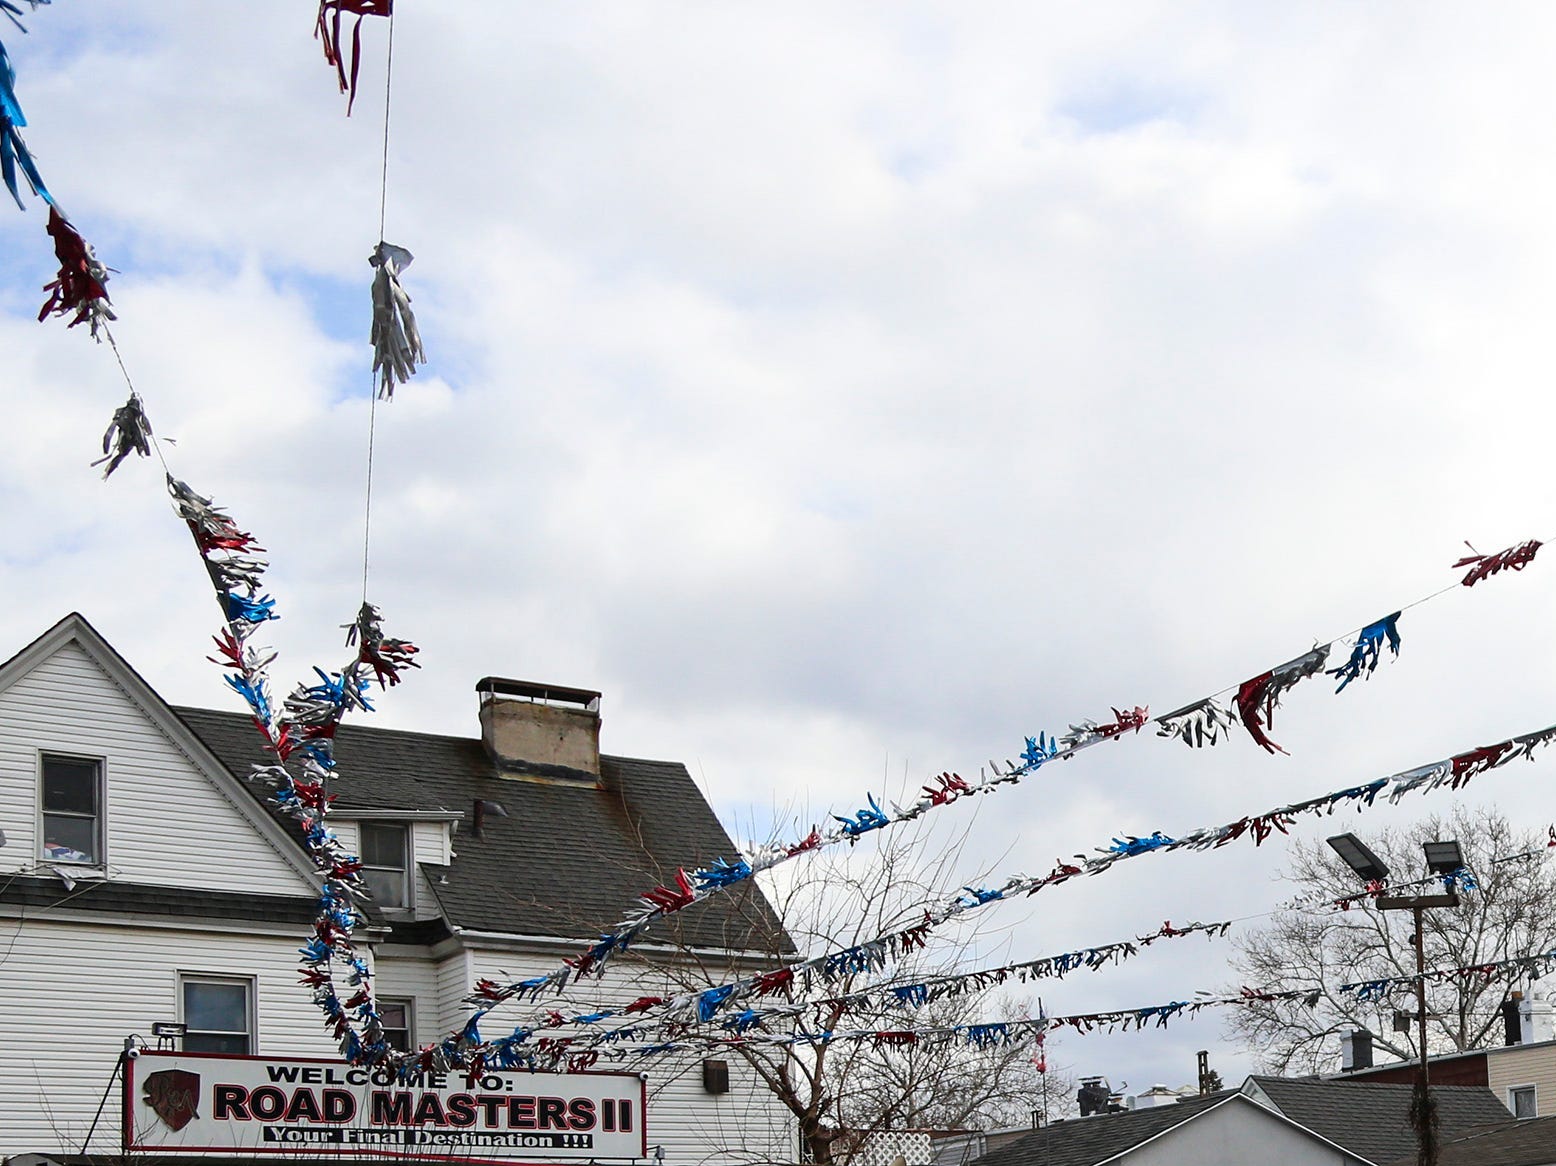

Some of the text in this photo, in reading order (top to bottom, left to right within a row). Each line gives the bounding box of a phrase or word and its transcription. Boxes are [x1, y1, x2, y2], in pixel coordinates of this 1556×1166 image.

[266, 1066, 447, 1089] WELCOME
[213, 1084, 356, 1124] ROAD
[371, 1090, 597, 1131] MASTERS
[602, 1099, 633, 1132] II
[271, 1127, 589, 1148] Your Final Destination !!!
